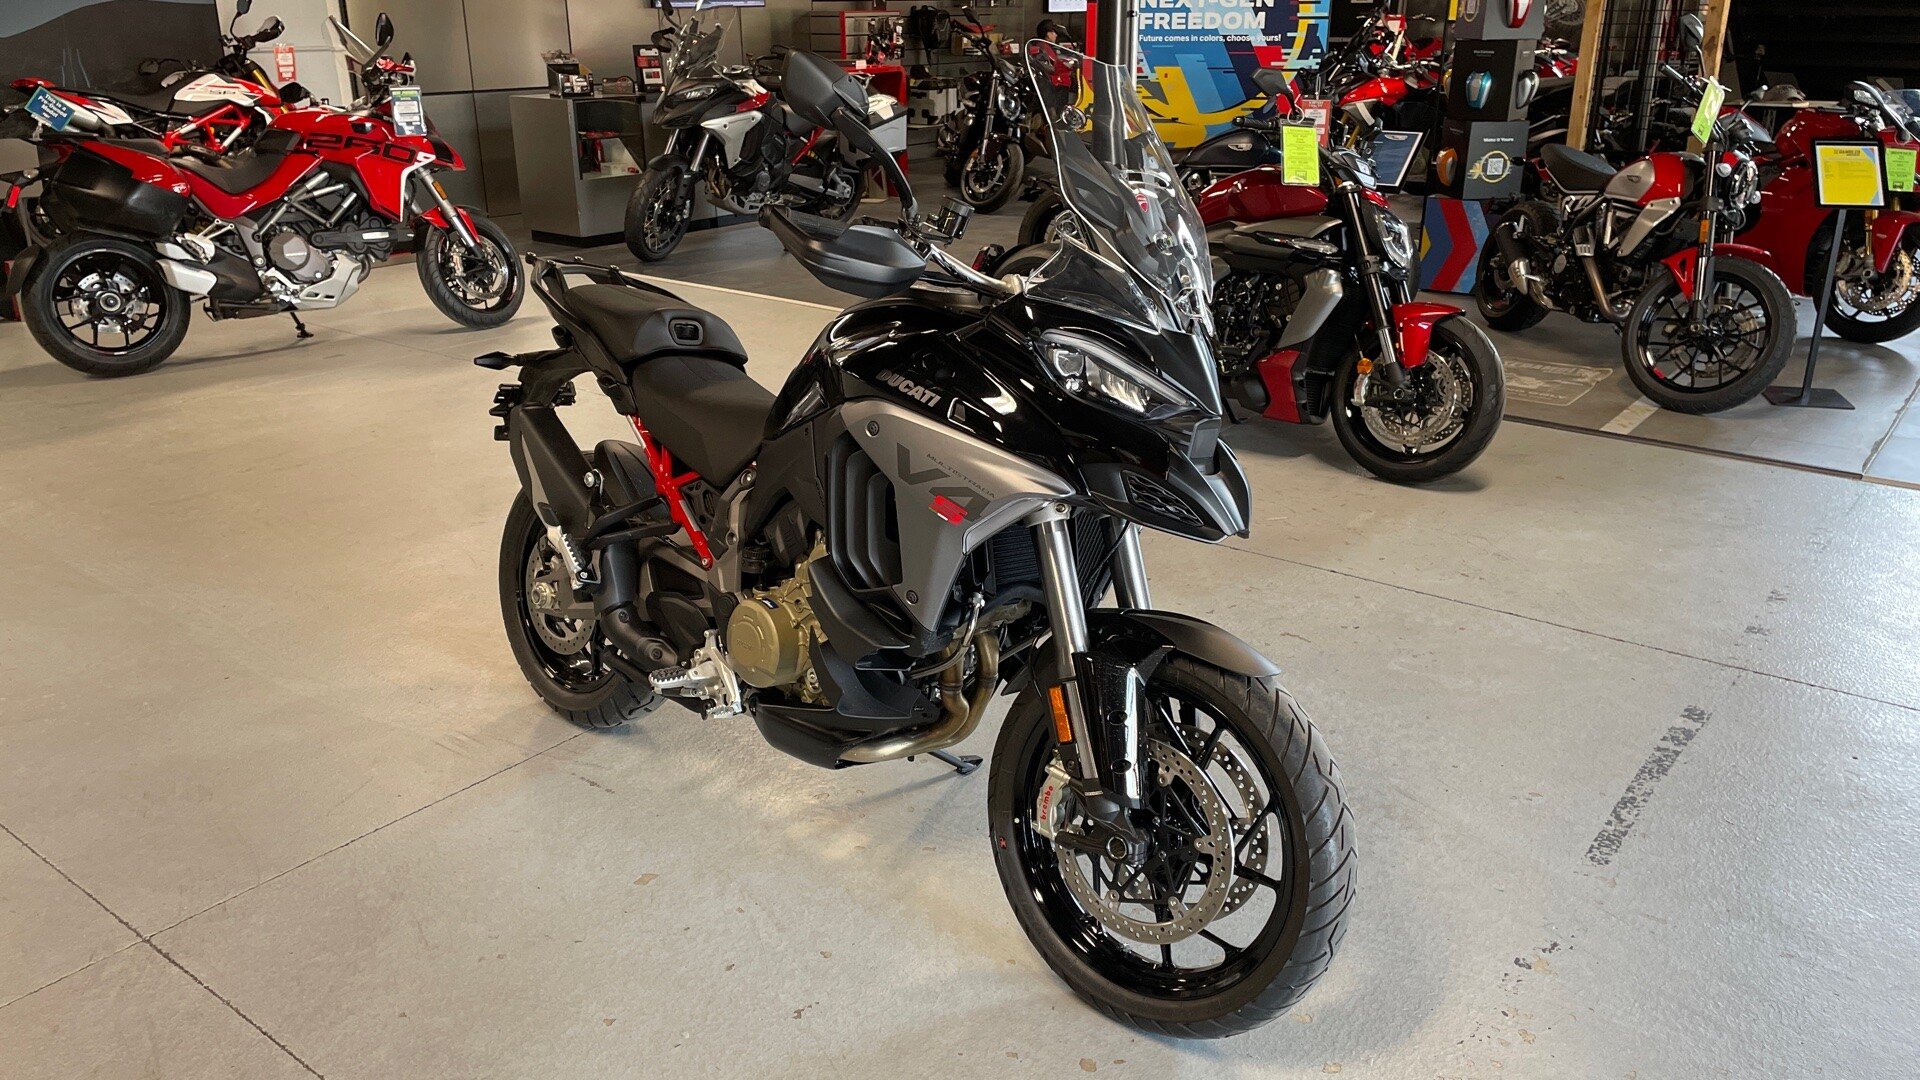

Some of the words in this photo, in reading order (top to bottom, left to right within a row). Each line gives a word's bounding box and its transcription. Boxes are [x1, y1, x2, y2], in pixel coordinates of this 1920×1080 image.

[1139, 12, 1266, 30] FREEDOM
[1138, 34, 1163, 42] Future
[1191, 34, 1198, 42] in
[1199, 34, 1225, 43] colors,
[1226, 34, 1255, 42] choose
[1256, 34, 1282, 44] yours!
[38, 95, 68, 118] Pre-Owned
[45, 94, 56, 104] This
[41, 104, 59, 118] Model
[876, 369, 942, 408] DUCATI
[926, 452, 996, 499] MULTISTRADA
[1040, 785, 1054, 820] brembo
